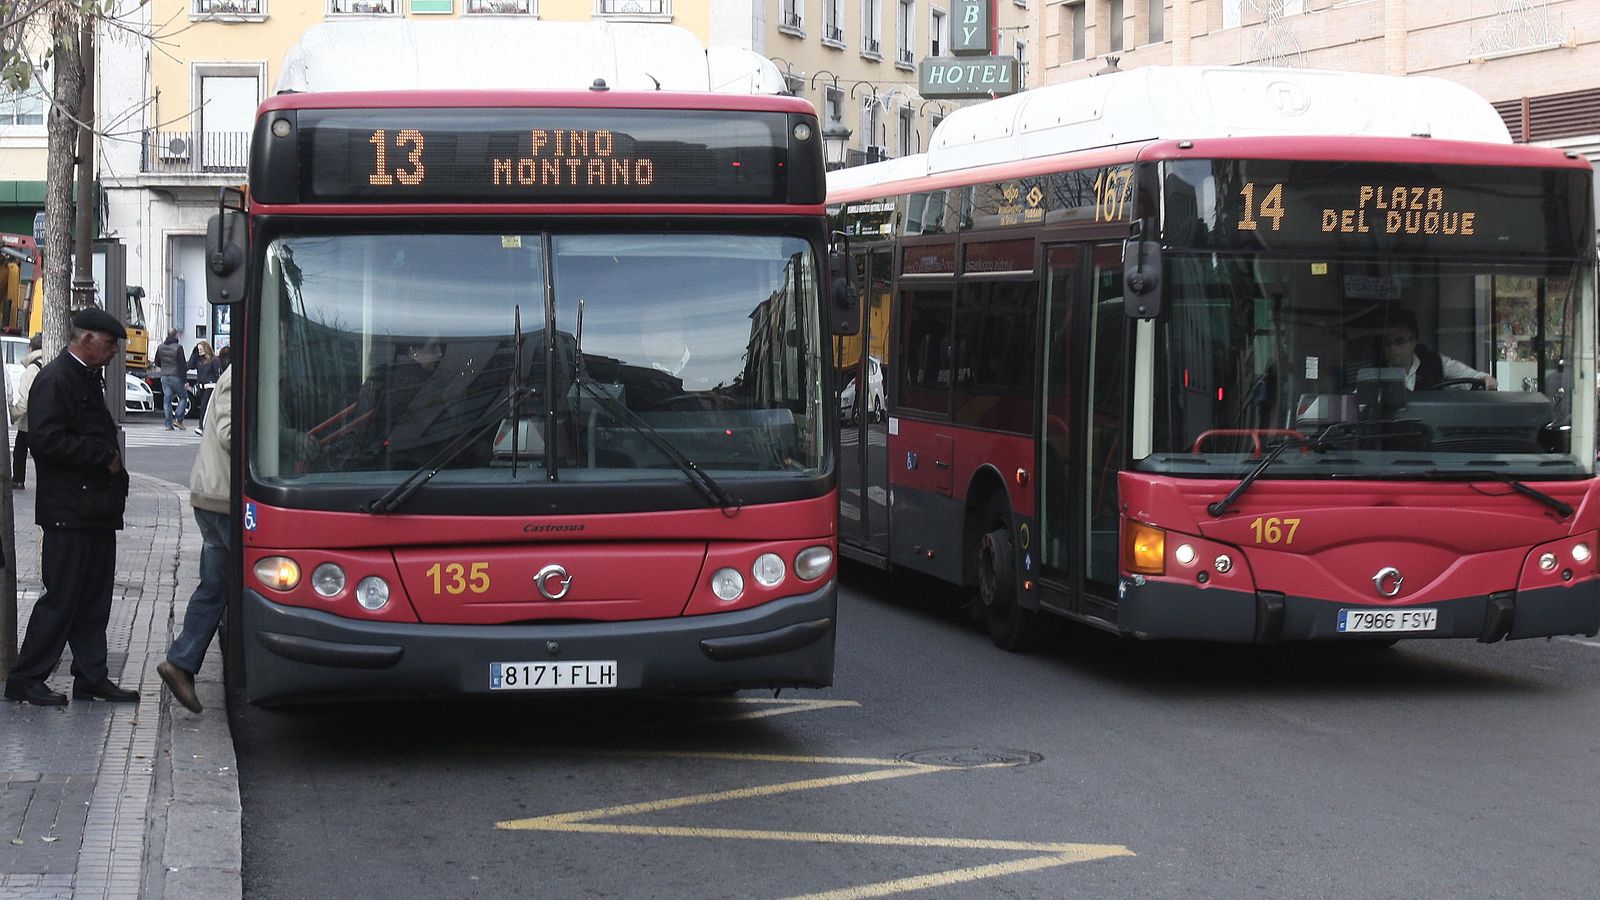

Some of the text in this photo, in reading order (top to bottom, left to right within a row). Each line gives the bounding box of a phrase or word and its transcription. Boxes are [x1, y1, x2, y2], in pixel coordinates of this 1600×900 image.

[962, 0, 980, 46] BY
[928, 64, 1010, 84] HOTEL
[532, 129, 612, 156] PINO
[369, 129, 424, 185] 13
[493, 158, 653, 185] MONTANO
[1094, 168, 1134, 223] 167
[1237, 182, 1285, 231] 14
[1359, 185, 1443, 211] PLAZA
[1321, 208, 1476, 236] DEL DUQUE
[523, 523, 585, 533] Castrosua
[1250, 517, 1301, 545] 167
[426, 562, 491, 595] 135
[1353, 612, 1432, 629] 7966 FSV
[505, 665, 612, 686] 8171 FLH
